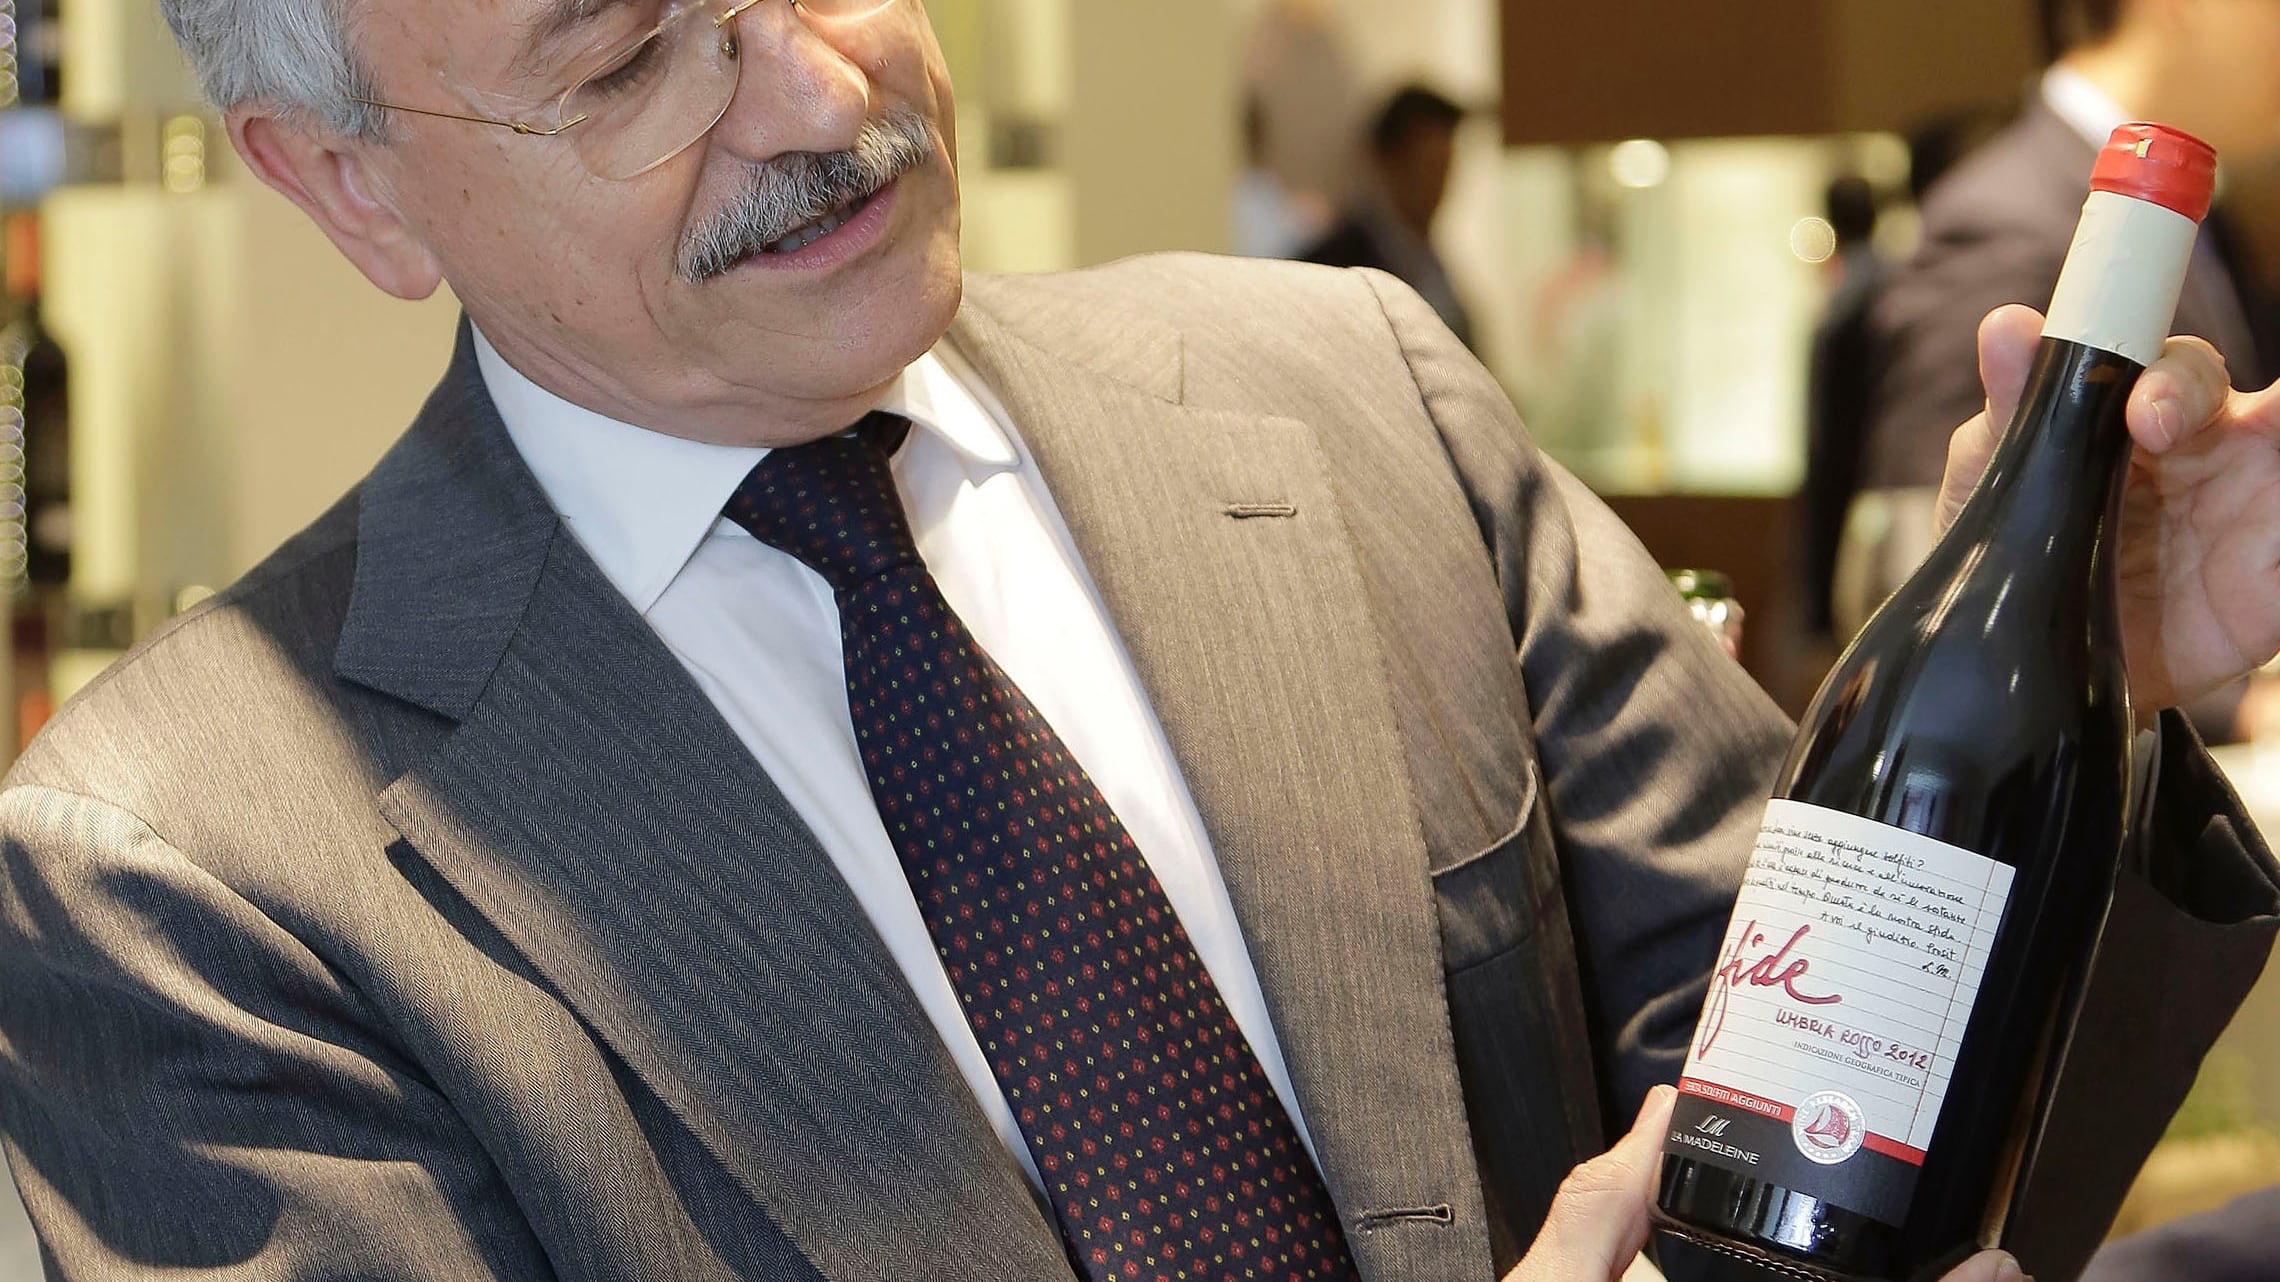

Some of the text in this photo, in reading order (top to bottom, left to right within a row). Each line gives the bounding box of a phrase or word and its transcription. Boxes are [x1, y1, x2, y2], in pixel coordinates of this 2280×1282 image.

[1776, 1008, 1928, 1070] UMBRIA ROSSO 2012
[1794, 1041, 1920, 1088] INDICAZIONE GEOGRAFICA TIPICA
[1731, 1092, 1782, 1116] AGGIUNTI
[1683, 1133, 1761, 1166] MADELEINE
